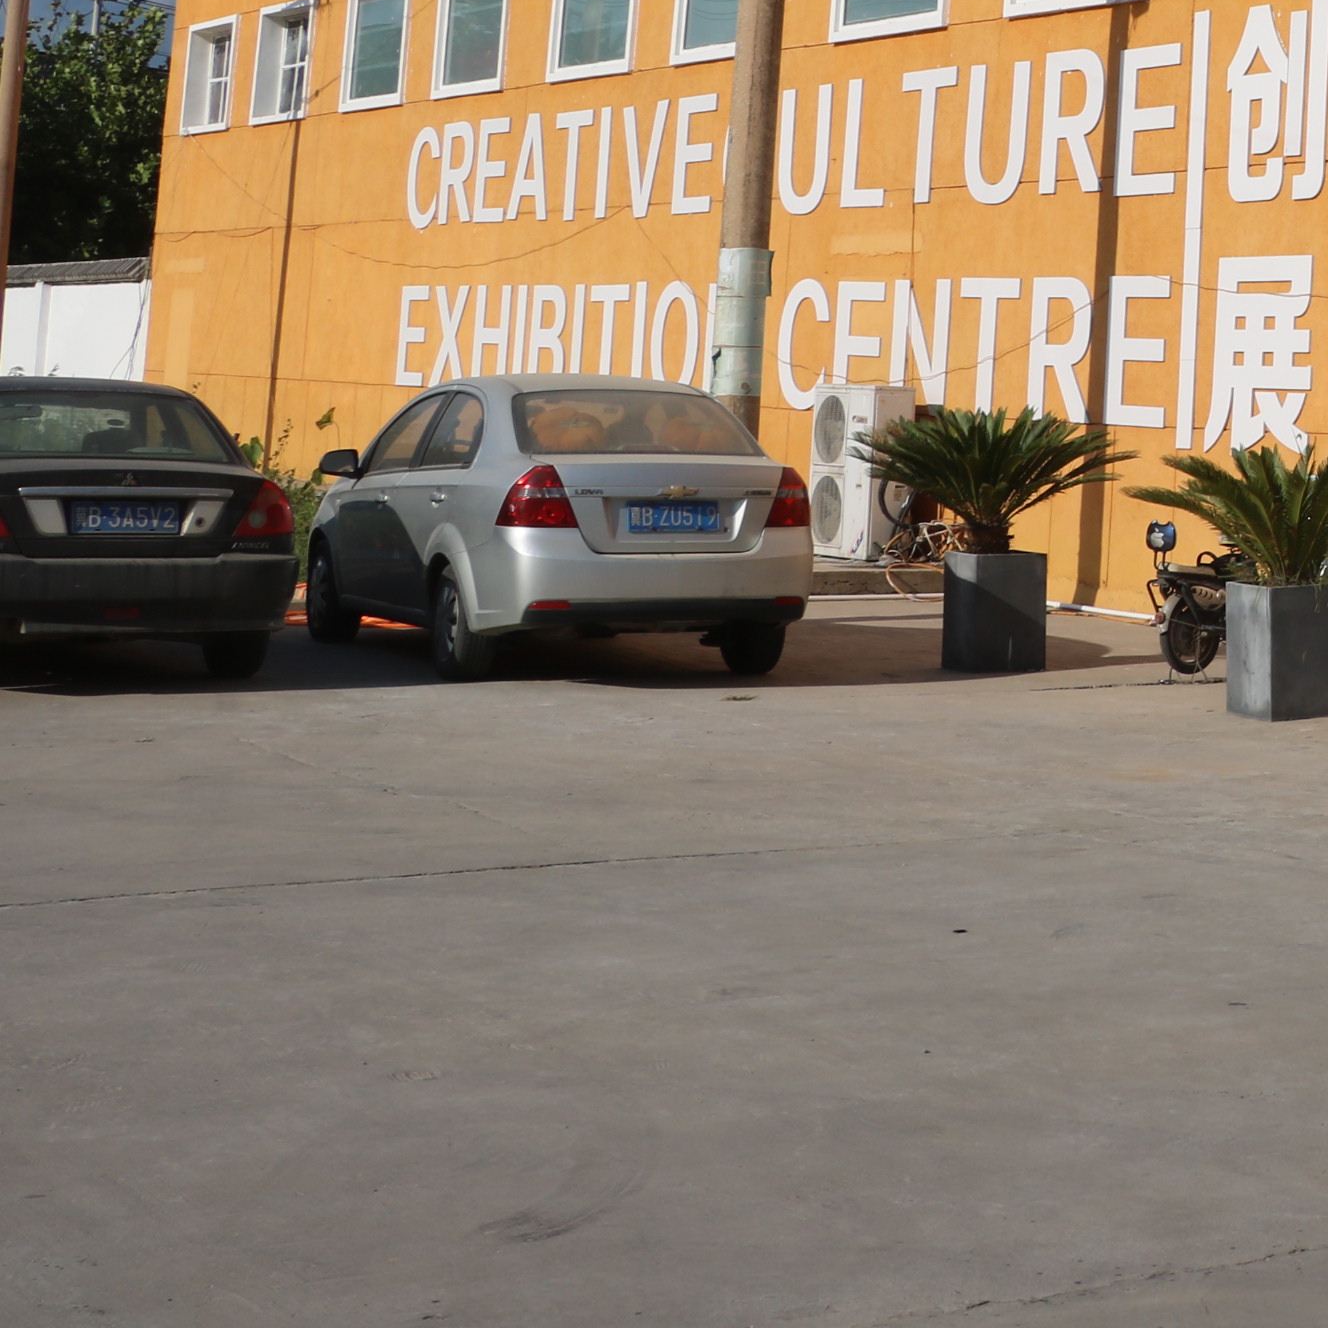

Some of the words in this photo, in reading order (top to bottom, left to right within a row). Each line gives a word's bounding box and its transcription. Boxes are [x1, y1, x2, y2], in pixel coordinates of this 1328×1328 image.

[406, 93, 718, 229] CREATIVE
[722, 43, 1182, 215] ULTURE
[395, 281, 717, 394] EXHIBITIO
[777, 275, 1172, 429] CENTRE
